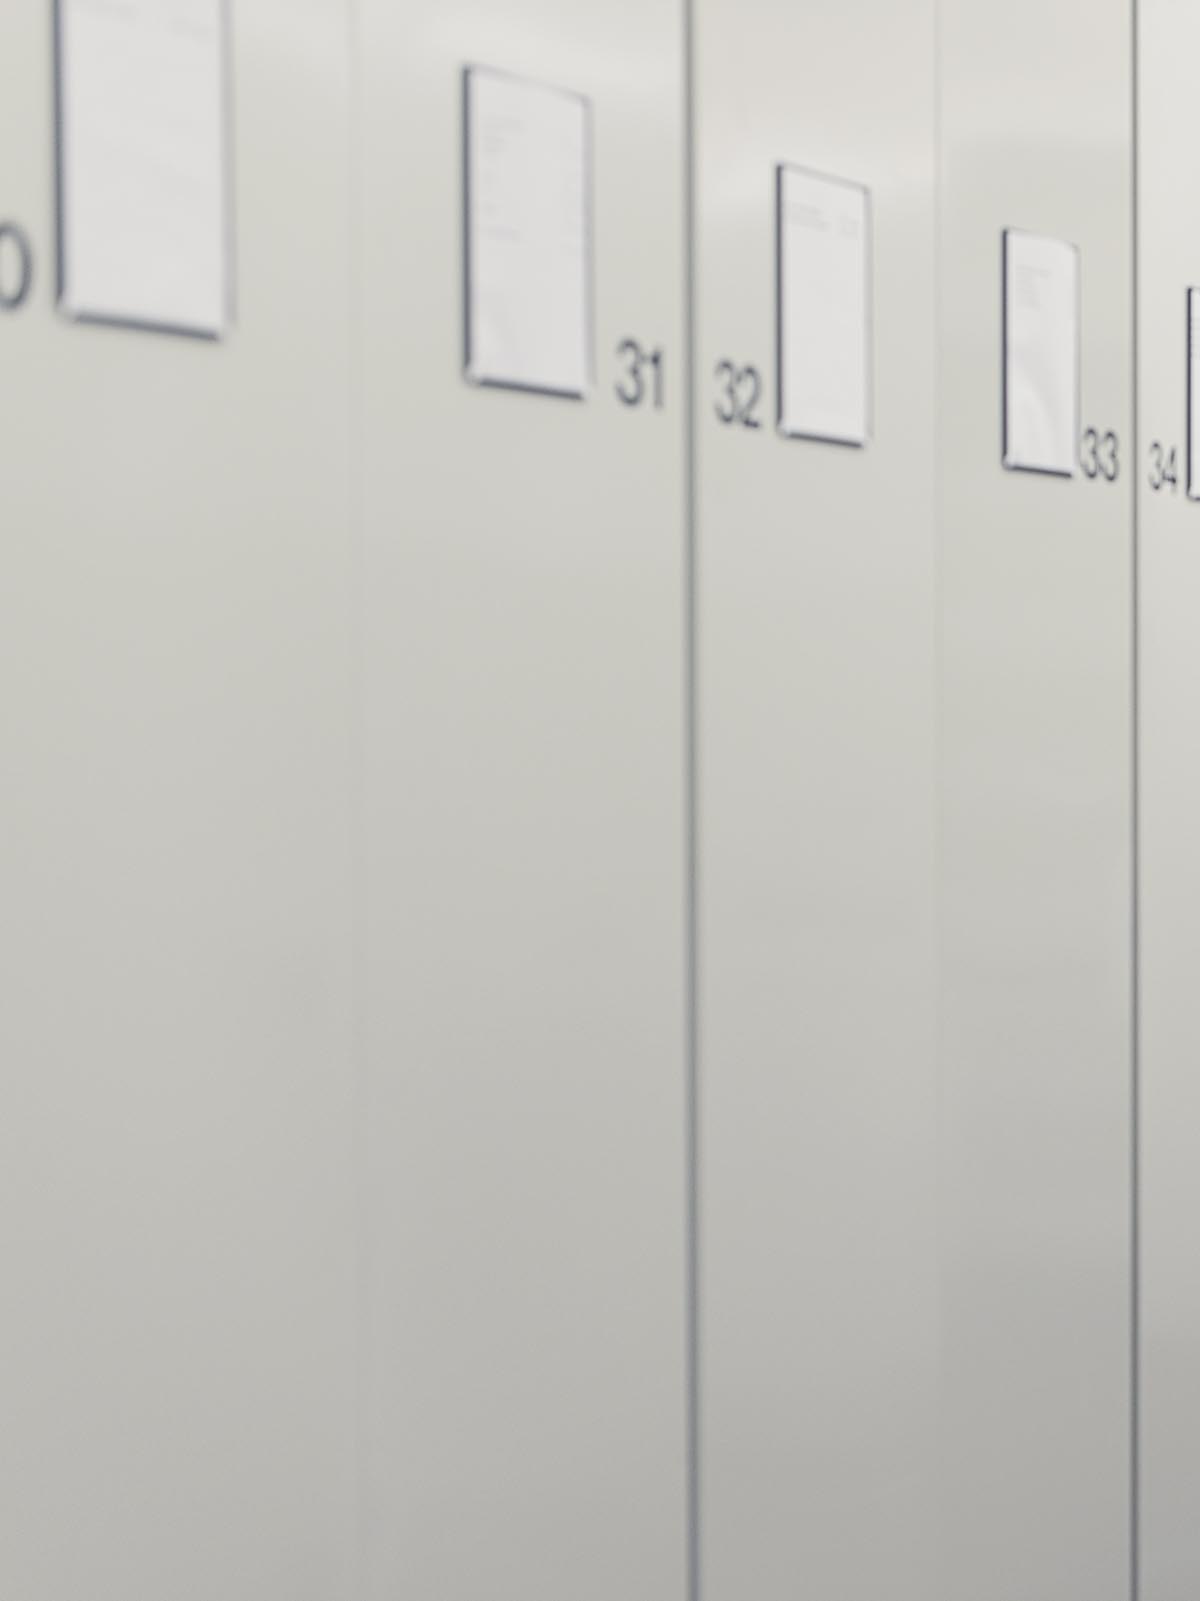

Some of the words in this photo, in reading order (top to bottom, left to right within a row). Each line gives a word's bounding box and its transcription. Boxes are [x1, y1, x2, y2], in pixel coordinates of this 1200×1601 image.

[615, 338, 664, 408] 31
[715, 360, 762, 429] 32
[1083, 427, 1119, 483] 33
[1149, 442, 1178, 492] 34
